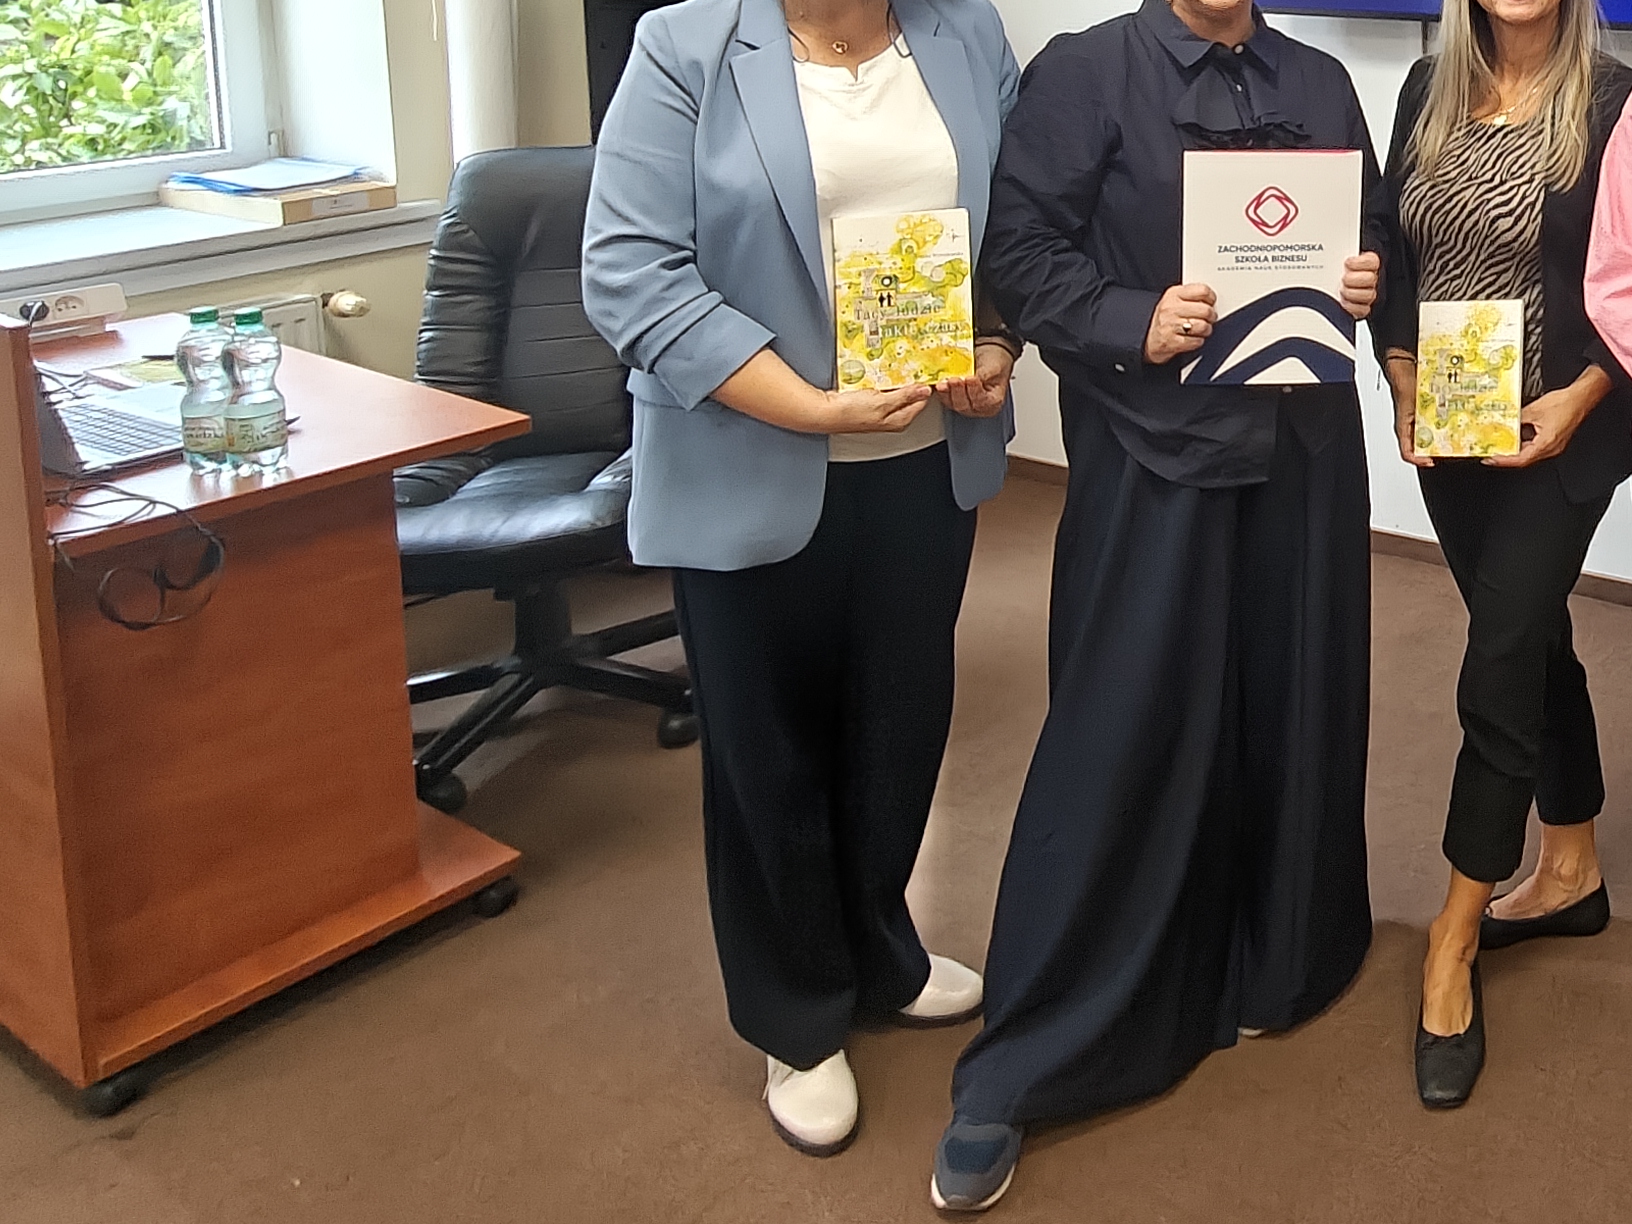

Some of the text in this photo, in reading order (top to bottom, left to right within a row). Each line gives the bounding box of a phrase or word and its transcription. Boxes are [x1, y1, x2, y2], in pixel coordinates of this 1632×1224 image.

[1217, 243, 1324, 253] ZACHODNIOPOMORSKA
[1234, 254, 1308, 264] SZKOŁA BIZNESU
